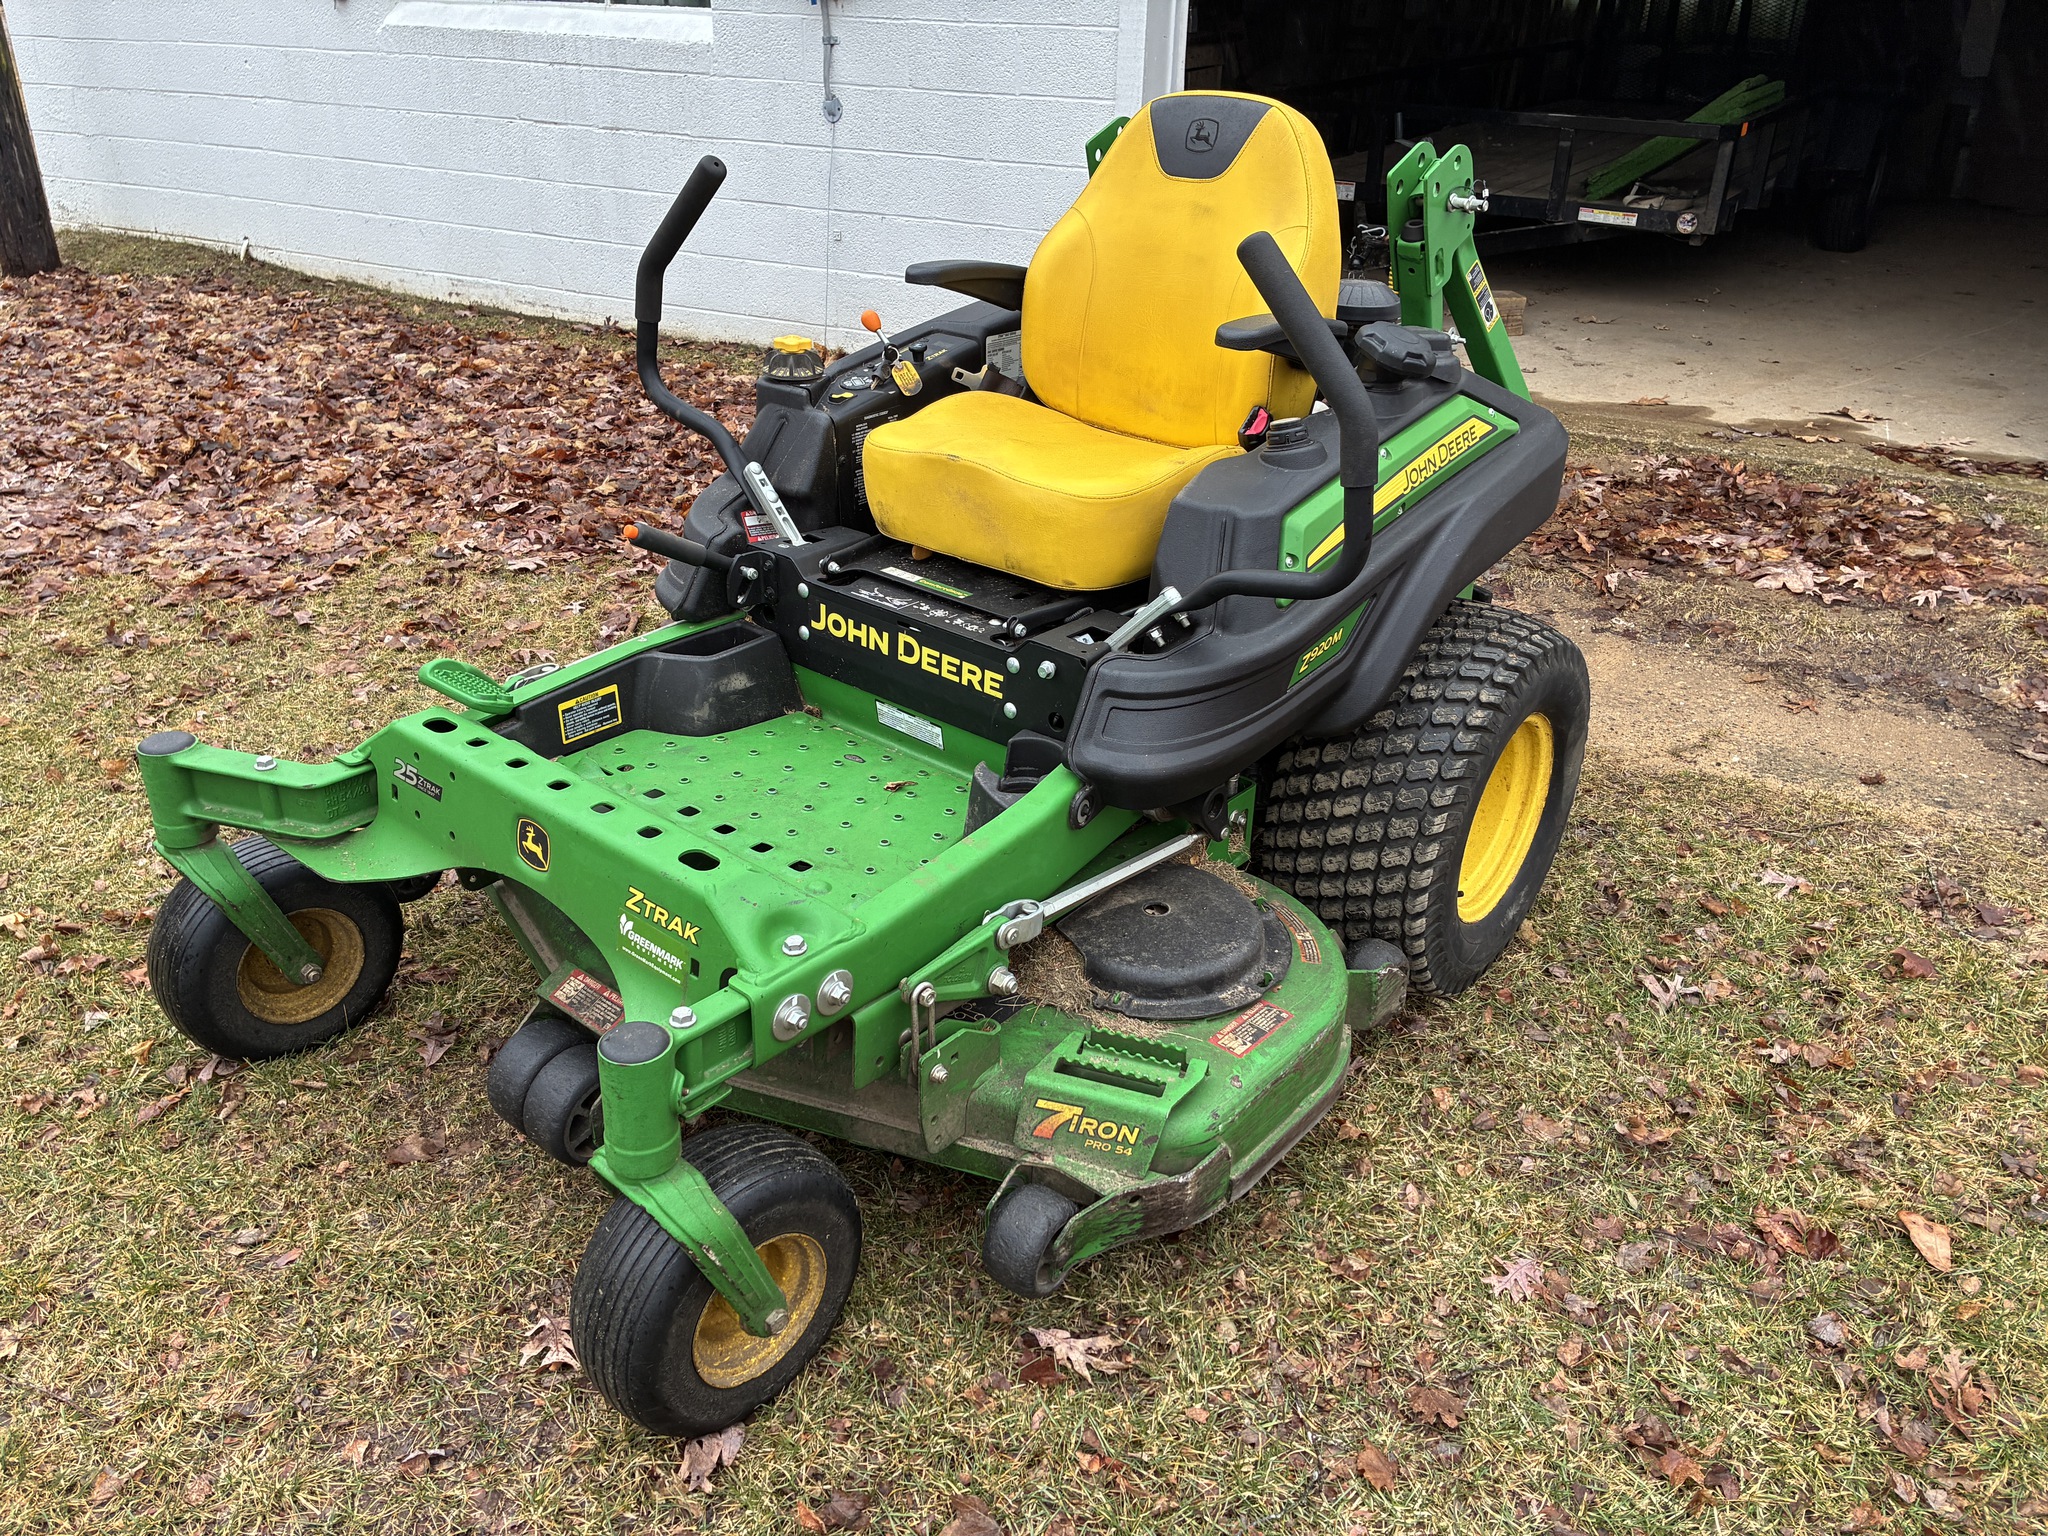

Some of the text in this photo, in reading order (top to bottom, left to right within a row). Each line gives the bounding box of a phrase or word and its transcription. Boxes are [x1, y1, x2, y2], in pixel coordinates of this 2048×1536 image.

[1402, 424, 1478, 492] JOHN DEERE
[810, 602, 1004, 700] JOHN DEERE
[1298, 627, 1344, 674] Z920M
[579, 692, 599, 703] CAUTION
[393, 757, 418, 786] 25
[417, 776, 441, 796] ZTRAK
[625, 885, 703, 948] ZTRAK
[627, 930, 684, 970] GREENMARK
[631, 941, 679, 972] EQUIPMENT
[1084, 1138, 1133, 1157] PRO 54
